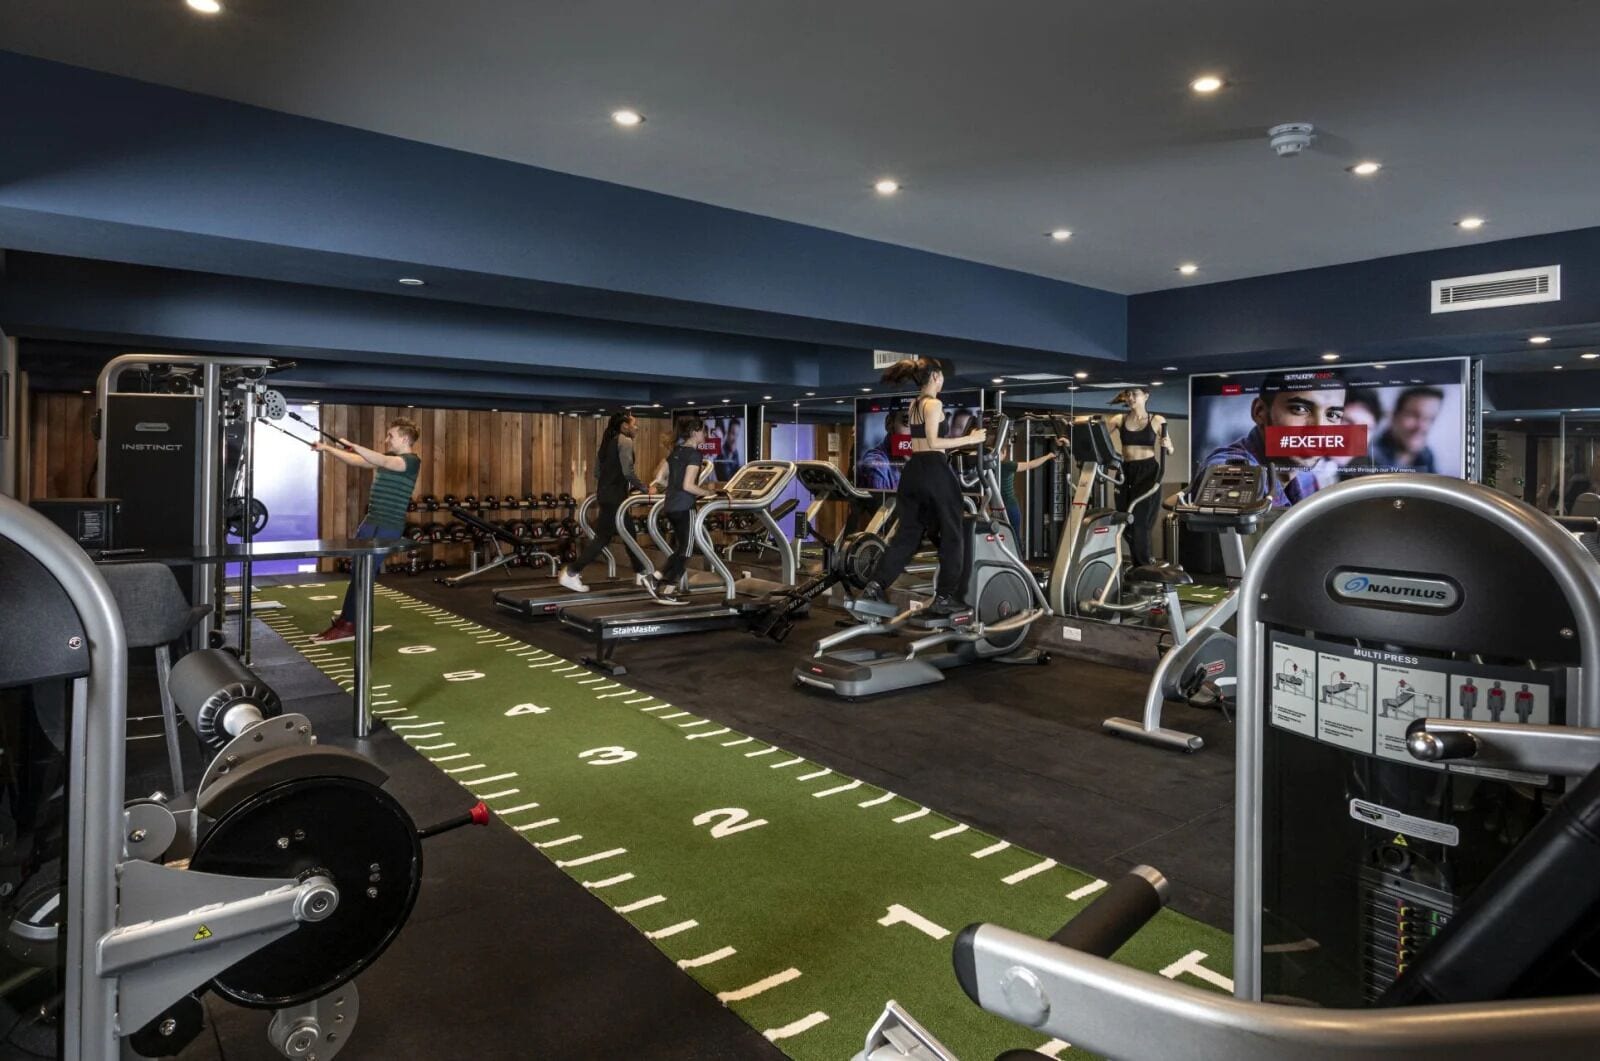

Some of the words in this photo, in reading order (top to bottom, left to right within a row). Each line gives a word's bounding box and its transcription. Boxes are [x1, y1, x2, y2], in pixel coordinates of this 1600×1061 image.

[121, 443, 183, 451] INSTINCT
[1279, 435, 1345, 448] #EXETER
[1367, 583, 1447, 600] NAUTILUS
[612, 625, 660, 636] StairMaster
[1353, 648, 1381, 660] MULTI
[1384, 653, 1419, 665] PRESS
[442, 669, 486, 682] 5
[503, 702, 551, 717] 4
[577, 745, 638, 766] 3
[692, 807, 769, 839] 2
[877, 903, 952, 940] 1
